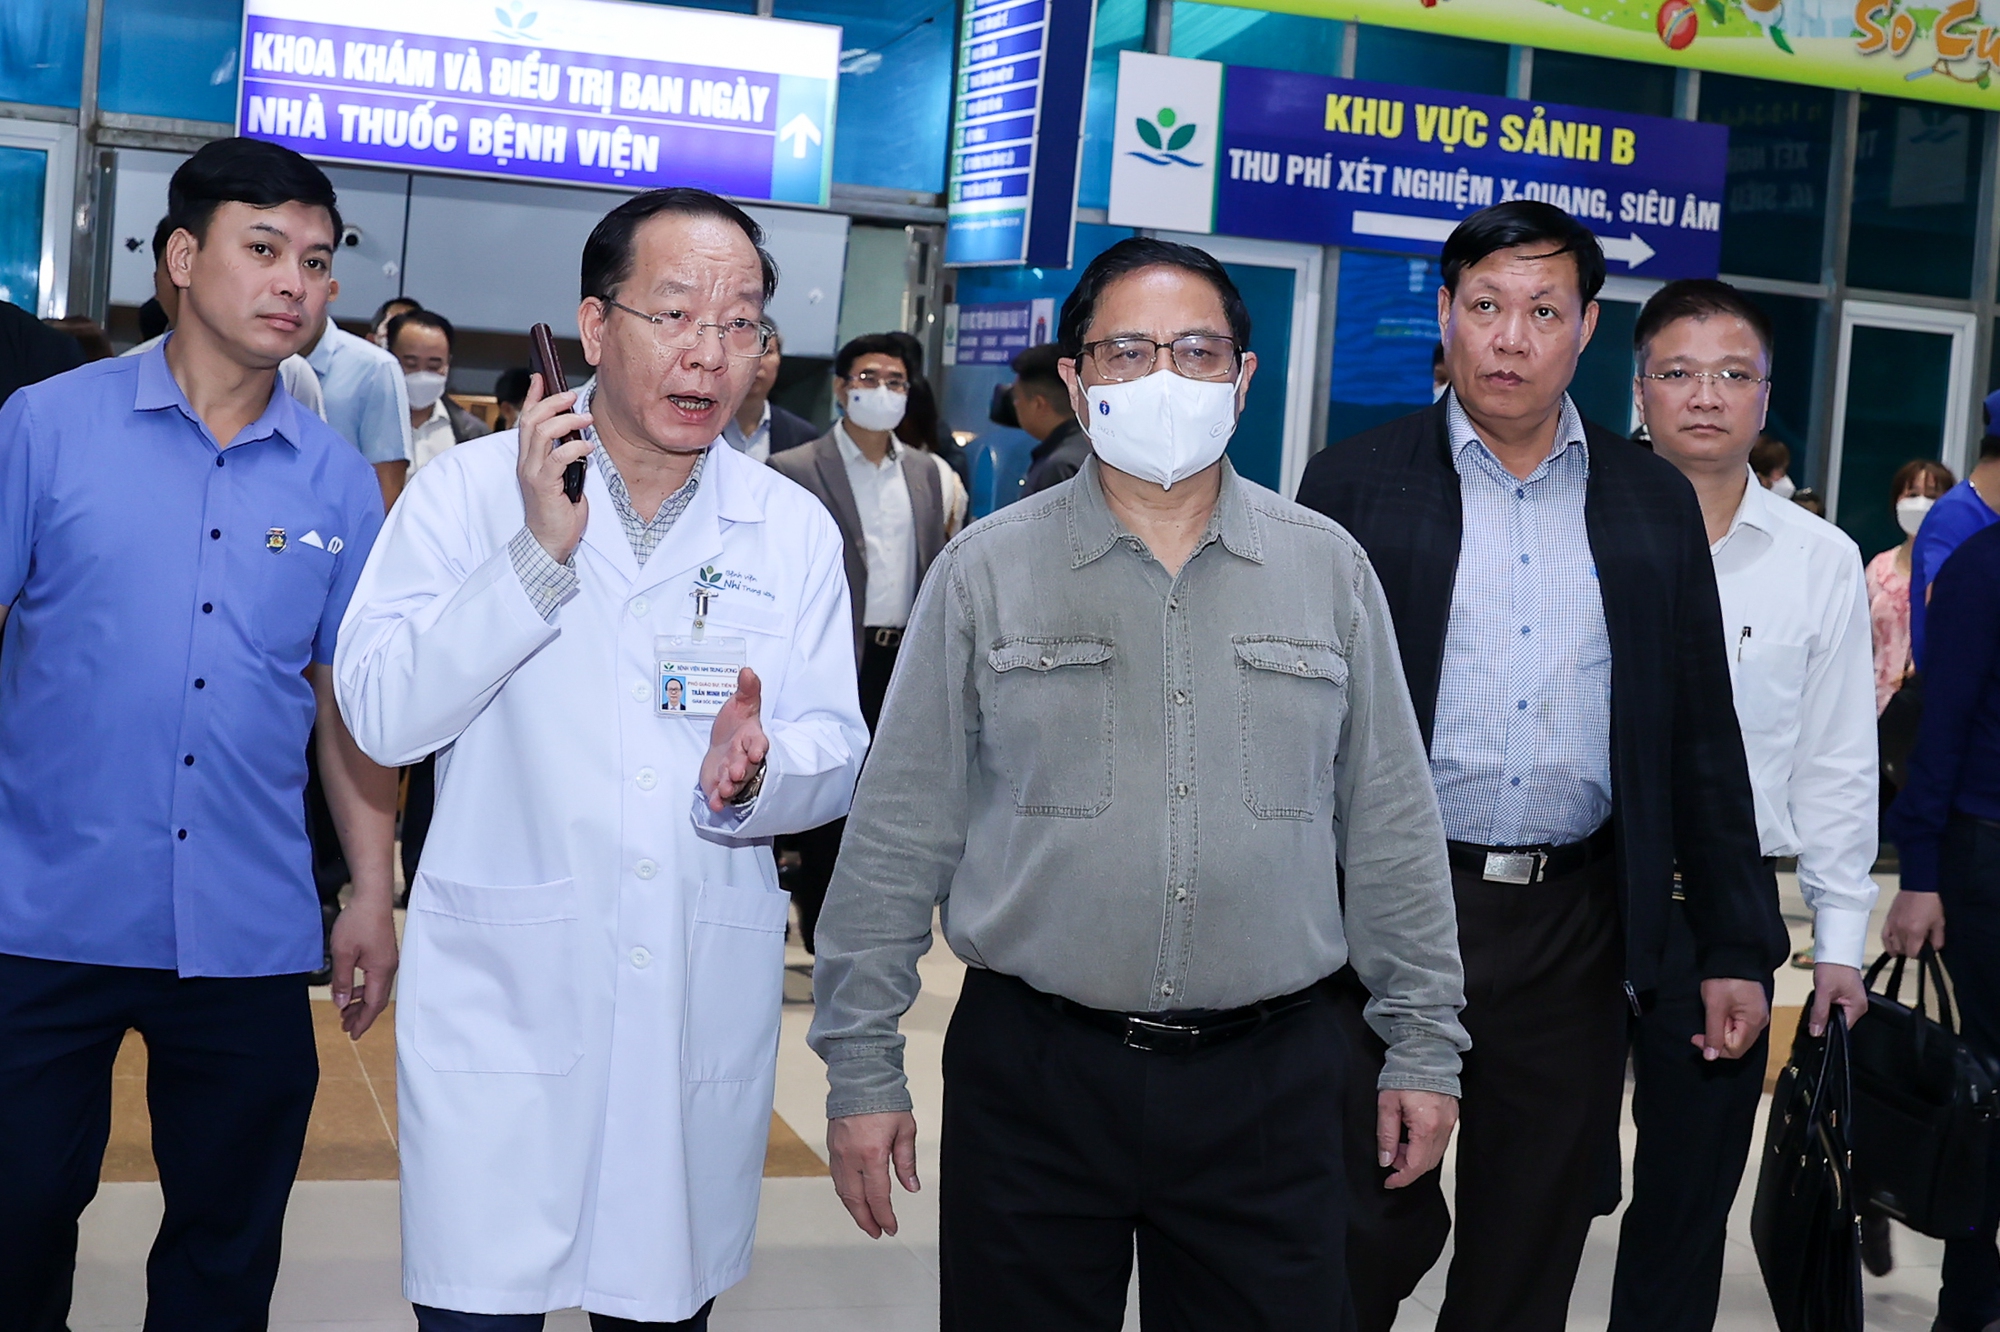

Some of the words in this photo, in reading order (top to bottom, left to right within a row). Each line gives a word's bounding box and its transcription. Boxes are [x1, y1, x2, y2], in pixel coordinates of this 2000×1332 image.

[251, 31, 336, 78] KHOA
[343, 39, 437, 88] KHÁM
[443, 47, 483, 93] VÀ
[566, 66, 614, 115] TRỊ
[619, 72, 684, 114] BAN
[689, 76, 771, 123] NGÀY
[247, 93, 327, 140] NHÀ
[337, 100, 459, 153] THUỐC
[468, 113, 567, 166] BỆNH
[576, 125, 660, 178] VIỆN
[1324, 93, 1404, 139] KHU
[1415, 103, 1489, 153] VỰC
[1498, 105, 1602, 162] SẢNH
[1610, 127, 1636, 165] B
[1228, 148, 1280, 184] THU
[1285, 152, 1332, 189] PHÍ
[1336, 156, 1387, 195] XÉT
[1391, 167, 1494, 210] NGHIỆM
[1619, 189, 1676, 226] SIÊU
[1680, 193, 1721, 231] ÂM
[723, 579, 741, 590] Nhi
